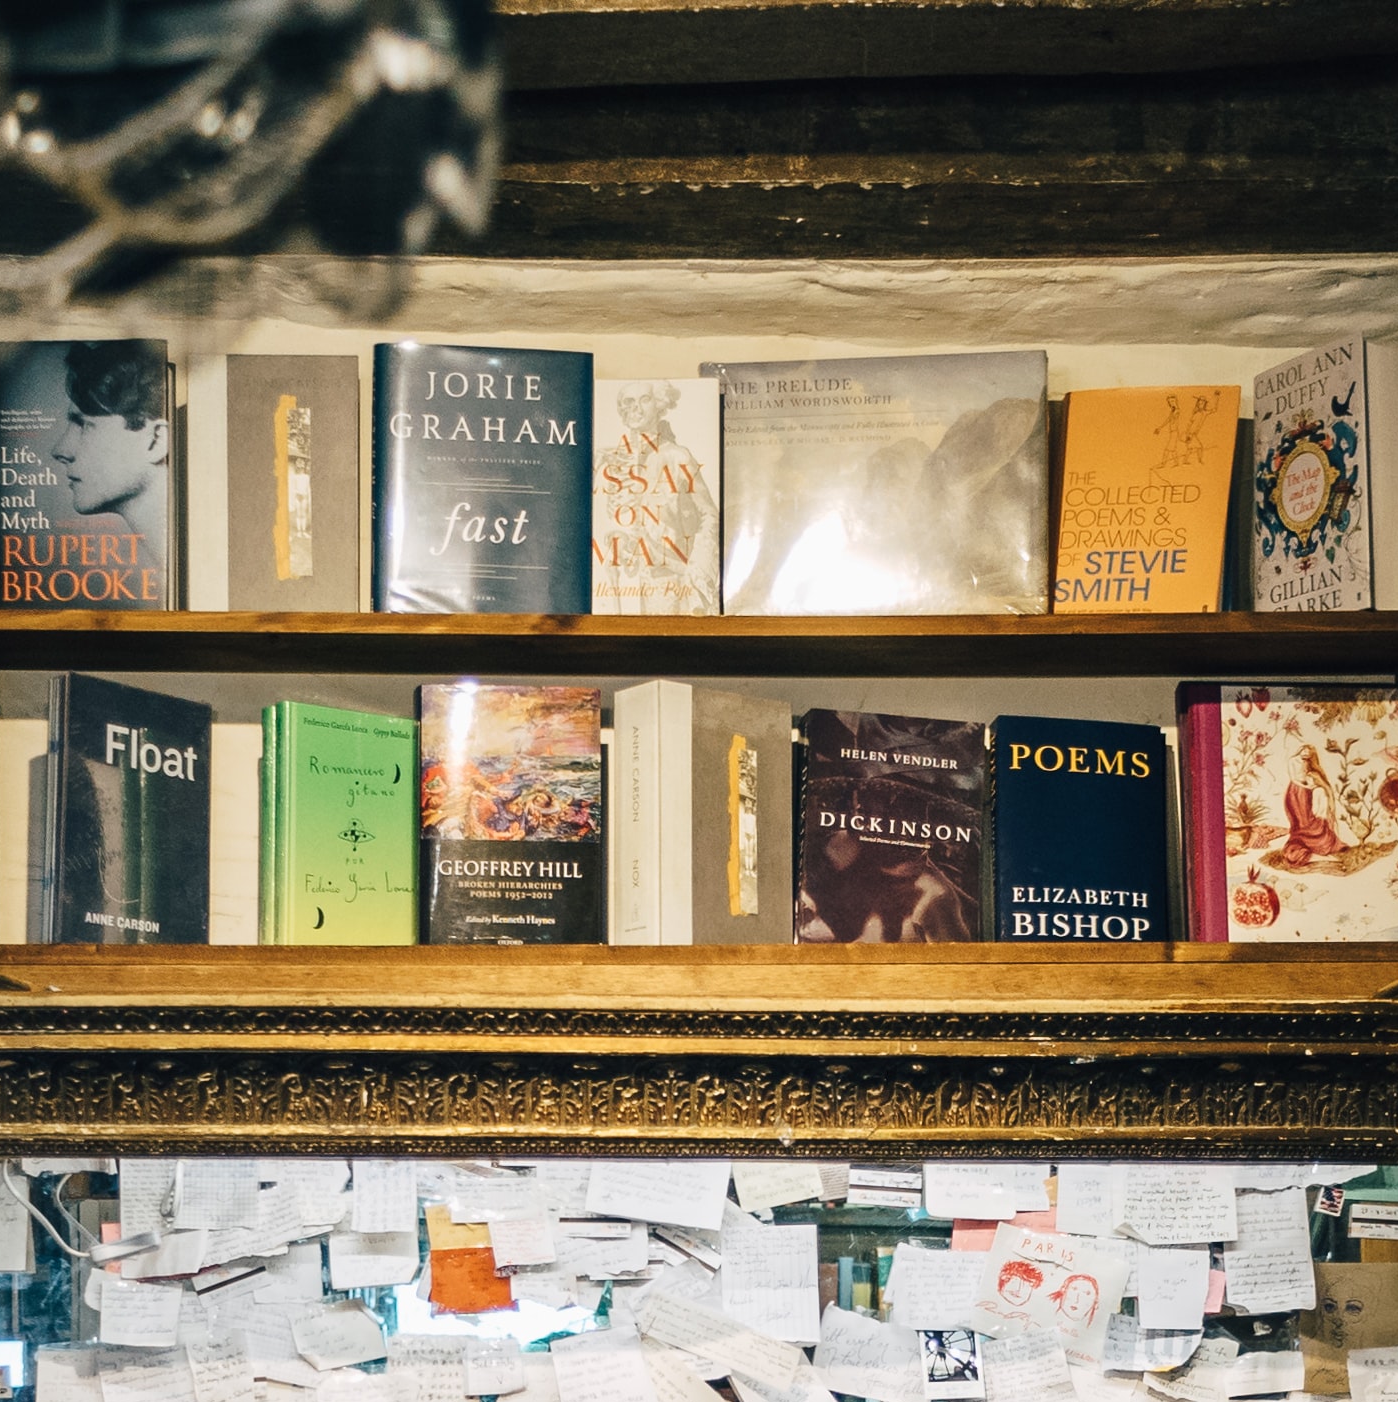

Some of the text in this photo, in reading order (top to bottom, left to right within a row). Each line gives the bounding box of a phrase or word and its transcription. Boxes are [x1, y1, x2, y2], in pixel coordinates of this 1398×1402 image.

[1255, 343, 1354, 400] CAROL ANN
[426, 372, 542, 401] JORIE
[765, 378, 853, 394] PRELUDE
[1275, 376, 1329, 416] DUFFY
[723, 394, 892, 412] WILLIAM WORDSWORTH
[390, 413, 578, 446] GRAHAM
[612, 432, 662, 455] AN
[1, 446, 42, 466] Life,
[1, 468, 57, 486] Death
[592, 464, 704, 495] SSAY
[1068, 471, 1097, 486] THE
[1, 489, 35, 508] and
[1065, 484, 1201, 507] COLLECTED
[1, 512, 50, 533] Myth
[614, 504, 661, 527] ON
[1062, 506, 1171, 528] POEMS &
[429, 502, 529, 556] fast
[1060, 528, 1187, 550] DRAWINGS
[3, 534, 146, 566] RUPERT
[1058, 549, 1188, 575] OF STEVIE
[2, 568, 158, 601] BROOKE
[1054, 578, 1150, 603] SMITH
[1270, 565, 1342, 604] GILLIAN
[303, 717, 330, 729] Federico
[106, 724, 198, 781] Float
[841, 748, 958, 770] HELEN VENDLER
[1009, 744, 1151, 778] POEMS
[346, 783, 395, 808] gitano
[632, 726, 641, 888] ANNE CARSON NOX
[819, 812, 972, 843] DICKINSON
[438, 859, 583, 878] GEOFFREY HILL
[458, 881, 563, 890] BROKEN HIERARCHIES
[470, 891, 501, 899] POEMS
[1012, 886, 1148, 908] ELIZABETH
[85, 911, 160, 933] ANNE CARSON
[492, 914, 525, 924] Kenneth
[526, 915, 556, 927] Haynes
[1012, 912, 1151, 942] BISHOP
[1021, 1238, 1075, 1262] PARIS
